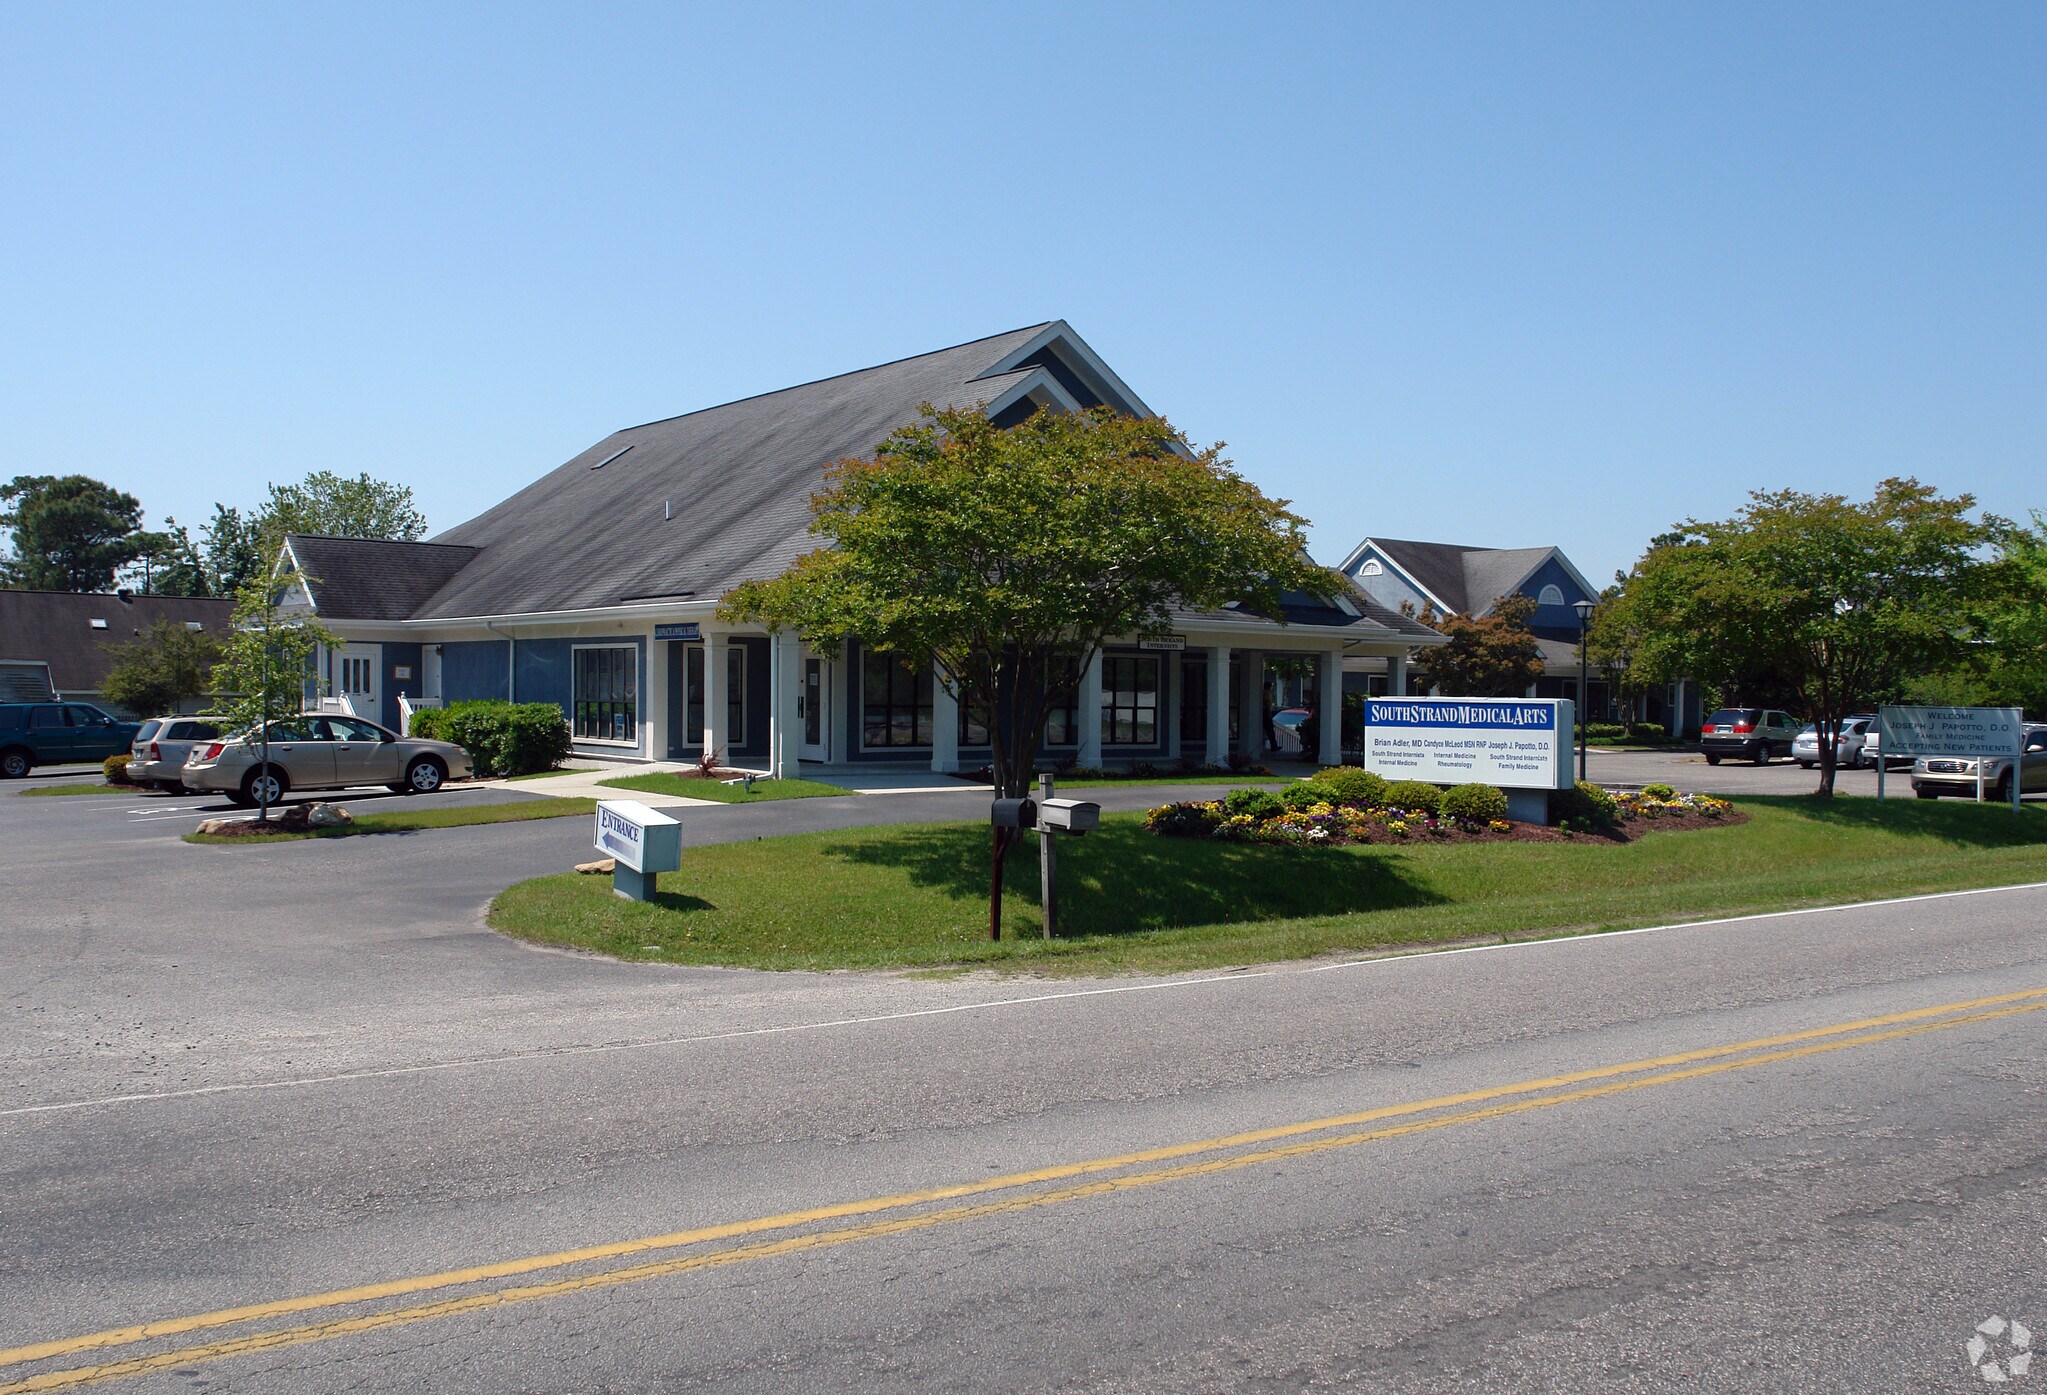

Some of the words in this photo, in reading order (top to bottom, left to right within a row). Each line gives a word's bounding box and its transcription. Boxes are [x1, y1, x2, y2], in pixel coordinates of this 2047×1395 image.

[1927, 712, 1975, 720] WELCOME
[1890, 722, 1926, 730] JOSEPH
[1946, 733, 1986, 741] MEDICINE
[1374, 738, 1391, 746] Brian
[1393, 739, 1411, 748] Adler,
[1412, 739, 1423, 747] MD
[1424, 739, 1444, 749] Candyce
[1445, 740, 1463, 748] McLeod
[1488, 741, 1508, 750] Joseph
[1509, 741, 1514, 749] J.
[1515, 742, 1538, 751] Papotto,
[1538, 742, 1550, 750] D.O.
[1889, 741, 1941, 750] ACCEPTING
[1944, 743, 1966, 751] NEW
[1969, 744, 2012, 752] PATIENTS
[1437, 761, 1473, 769] Rheumatology
[601, 809, 639, 842] ENTRANCE
